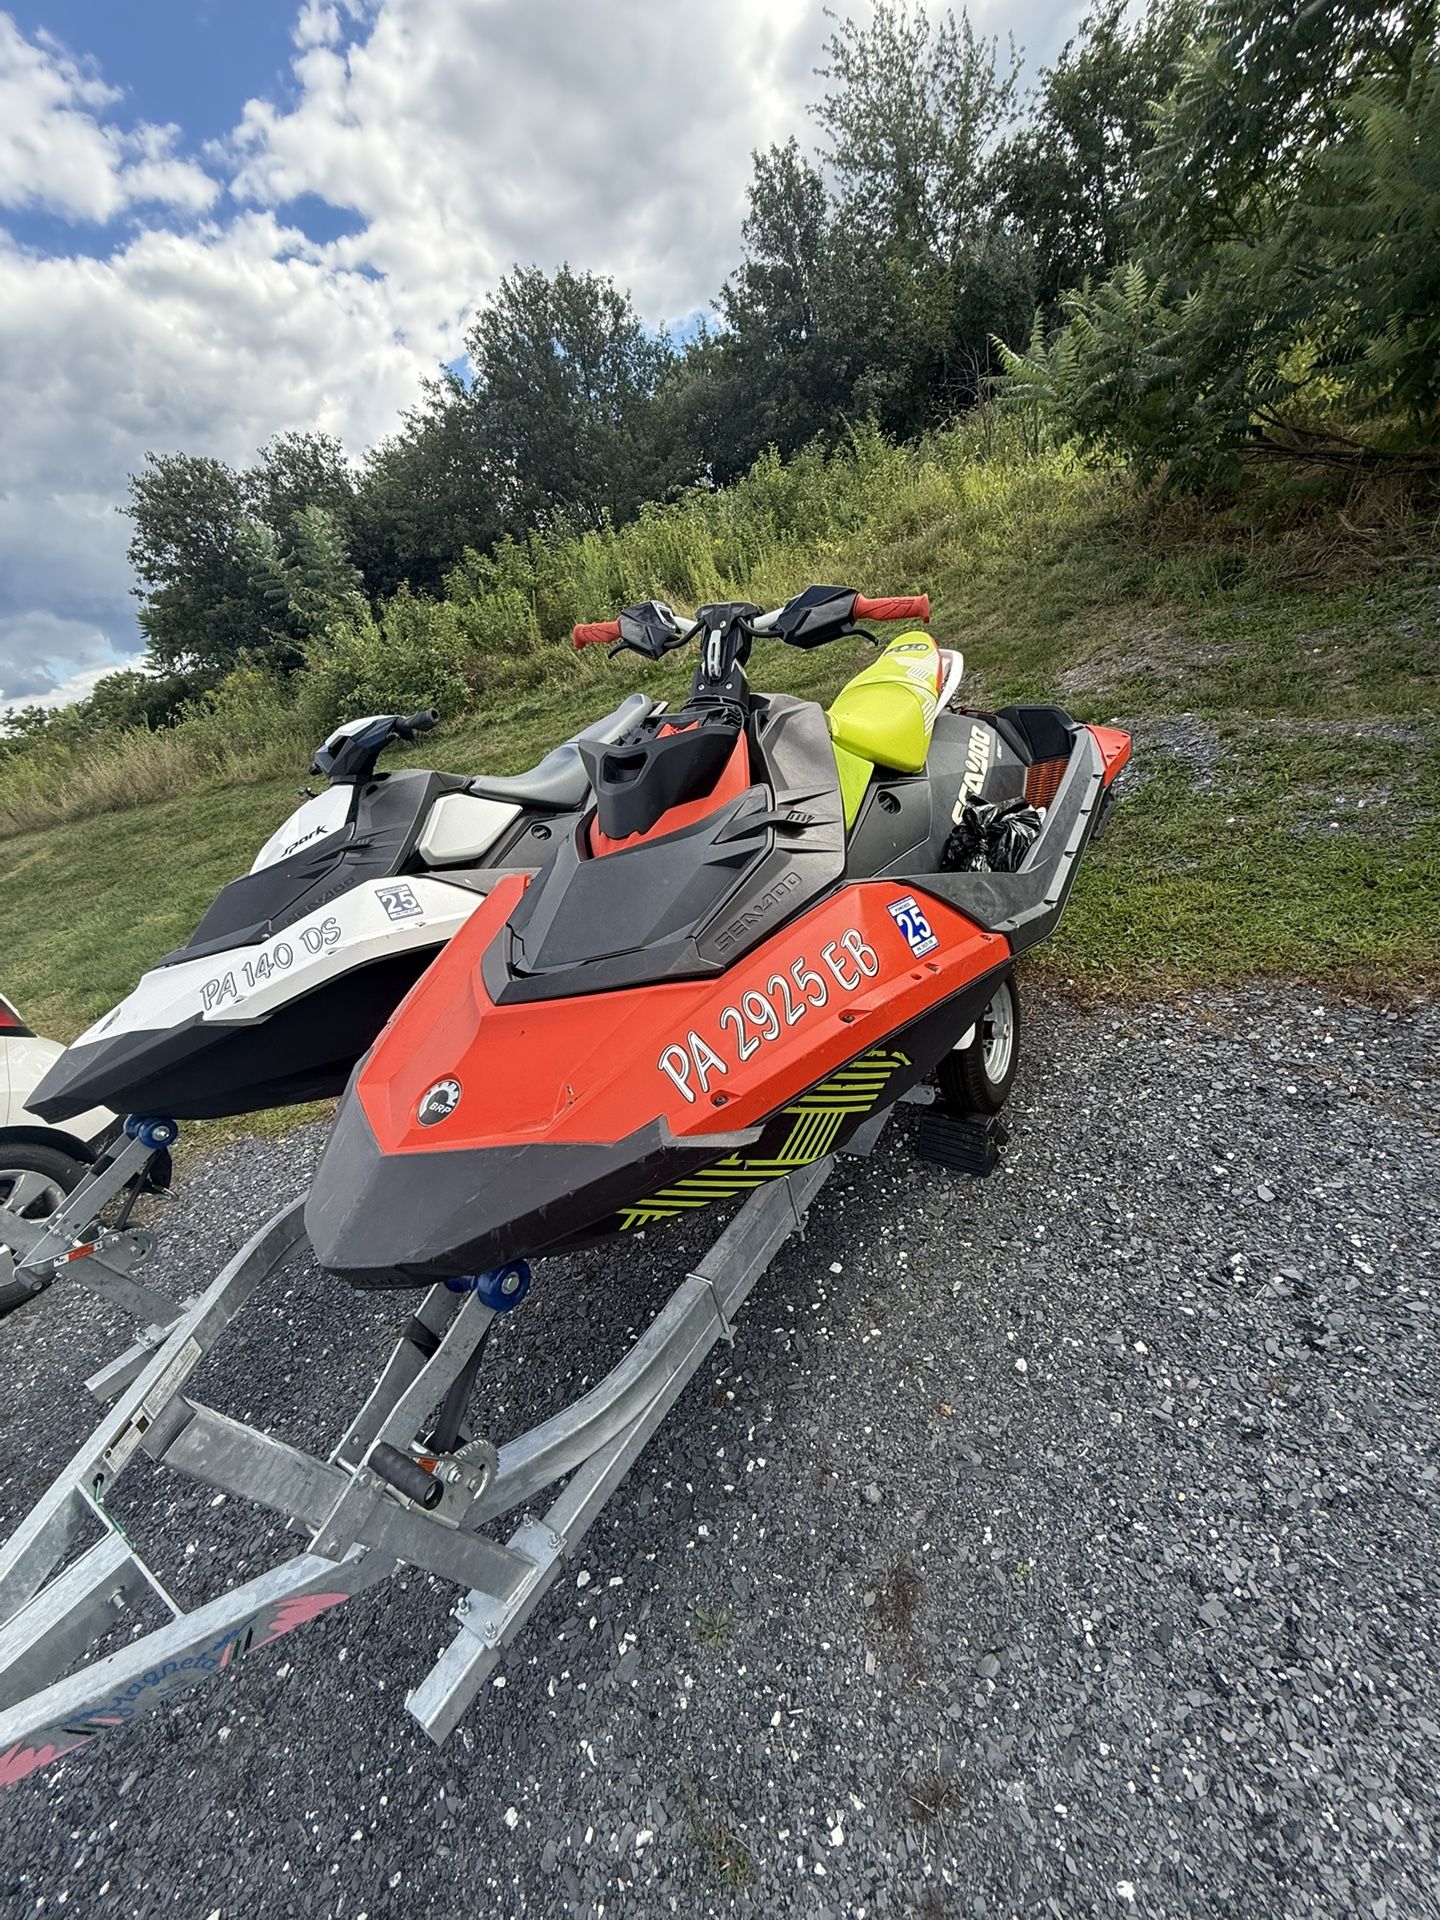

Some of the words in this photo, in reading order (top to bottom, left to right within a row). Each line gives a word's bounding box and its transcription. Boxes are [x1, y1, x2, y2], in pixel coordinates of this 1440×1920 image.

[381, 892, 417, 914] 25
[896, 905, 932, 947] 25
[200, 971, 238, 1011] PA
[242, 942, 293, 988] 140
[299, 917, 342, 954] DS
[657, 1030, 728, 1103] PA
[719, 956, 828, 1062] 2925
[820, 928, 879, 991] EB
[428, 1101, 452, 1114] BRP
